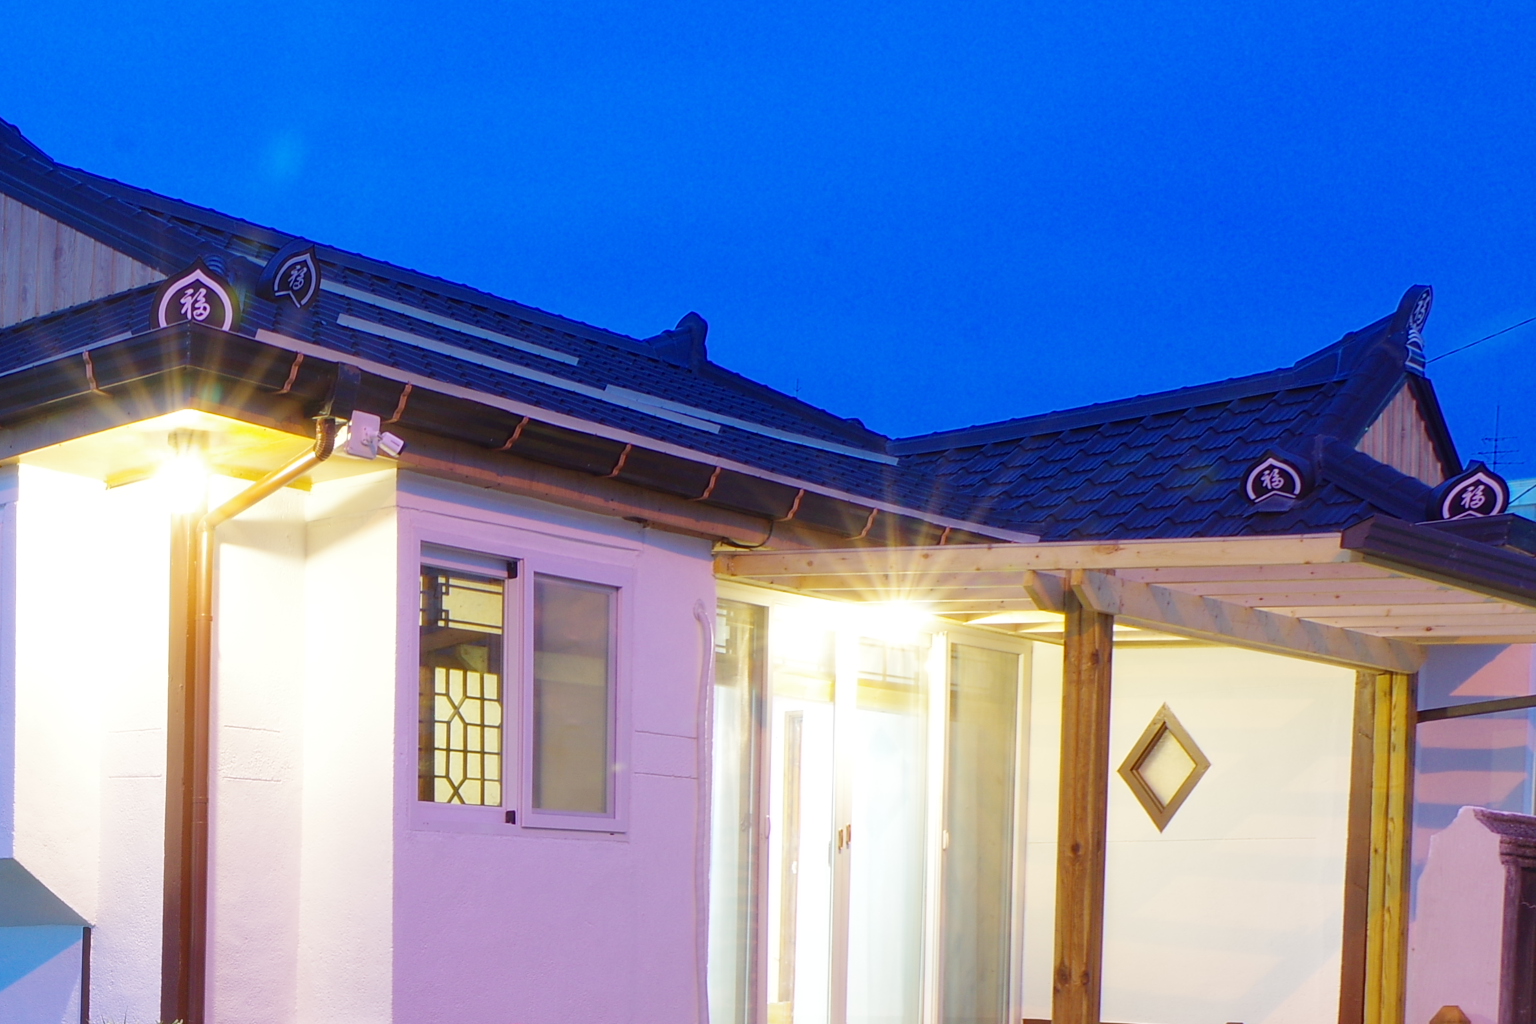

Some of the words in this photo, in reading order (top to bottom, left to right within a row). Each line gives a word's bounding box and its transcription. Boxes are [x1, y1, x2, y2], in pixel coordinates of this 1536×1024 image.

[180, 288, 211, 321] 福
[1261, 469, 1284, 490] 福
[1461, 485, 1485, 509] 福
